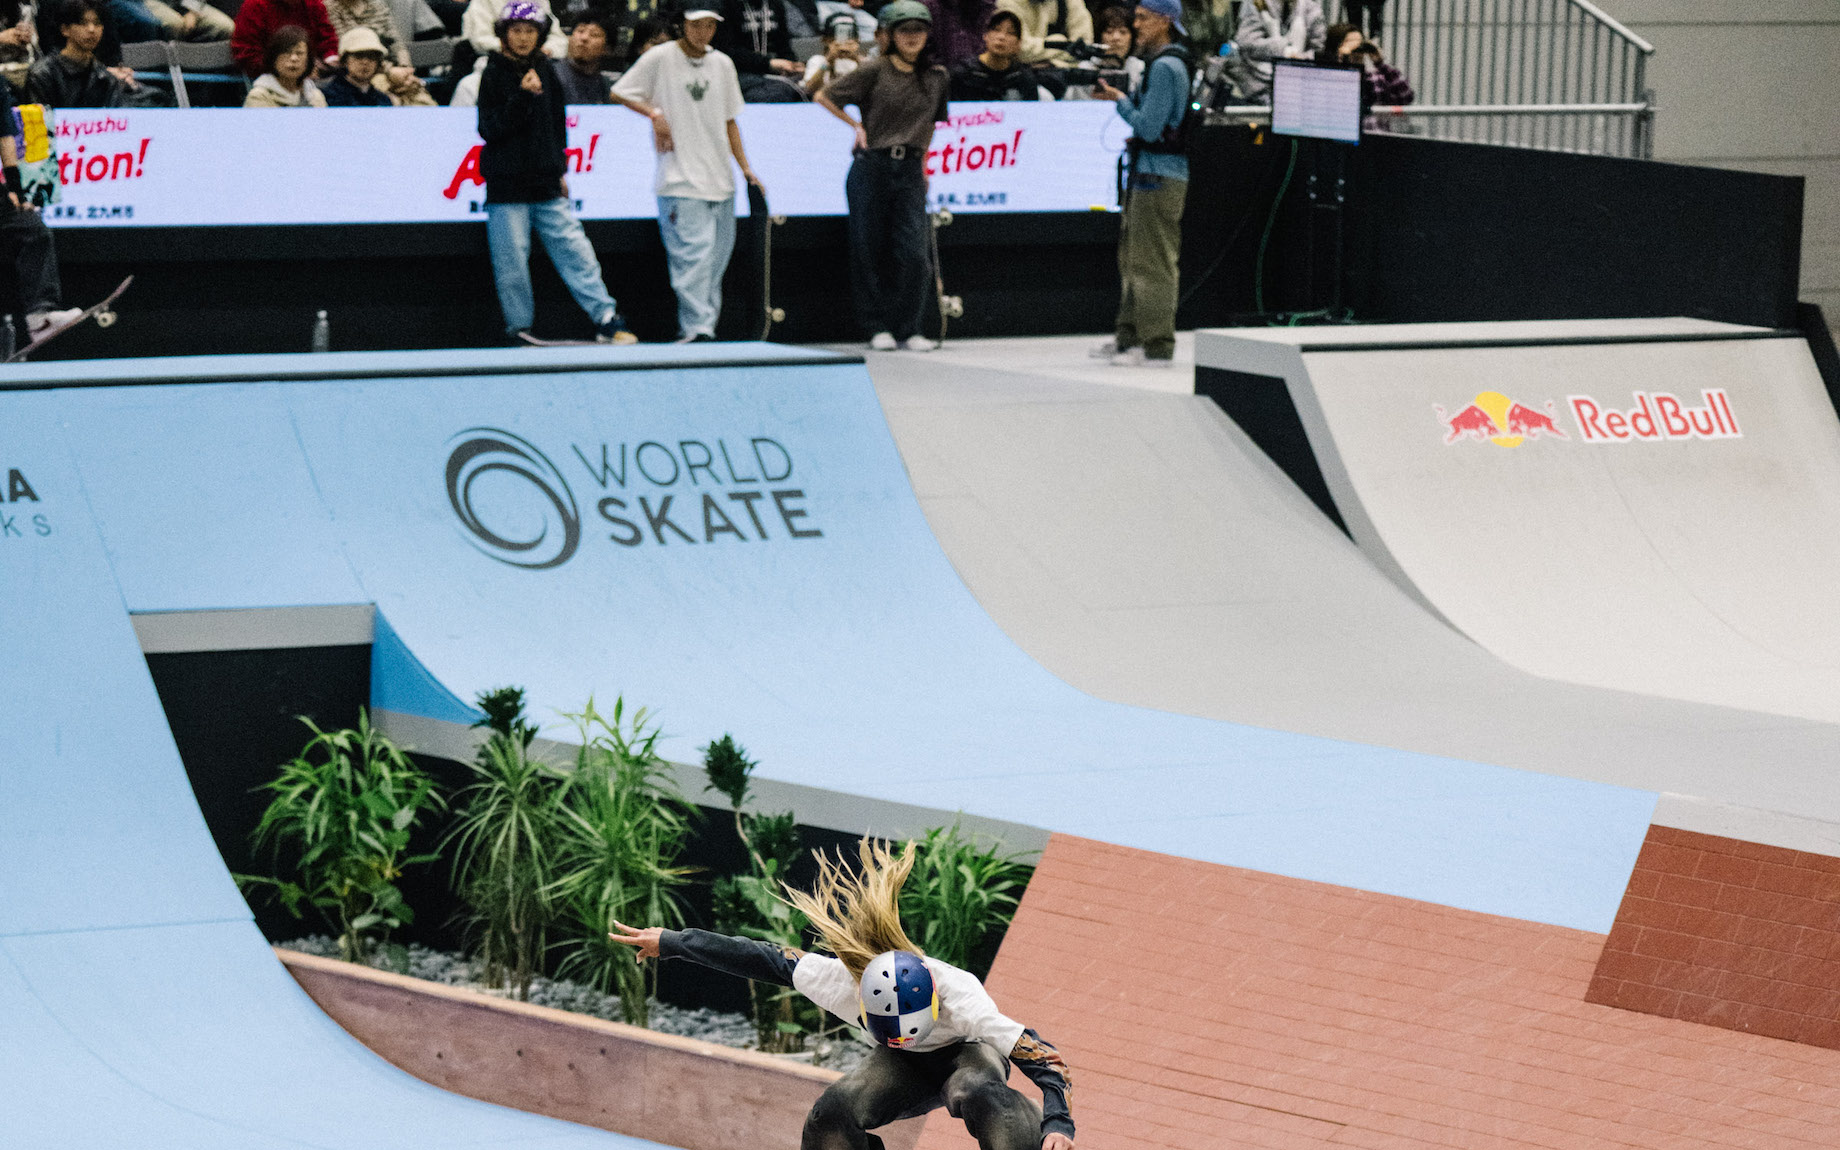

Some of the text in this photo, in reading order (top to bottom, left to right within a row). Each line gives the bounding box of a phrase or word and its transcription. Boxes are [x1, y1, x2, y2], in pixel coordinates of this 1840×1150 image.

[57, 138, 152, 185] tion!
[923, 129, 1024, 175] ction!
[1572, 392, 1738, 439] Red Bull
[0, 468, 40, 502] A
[572, 437, 793, 488] WORLD
[597, 490, 824, 547] SKATE
